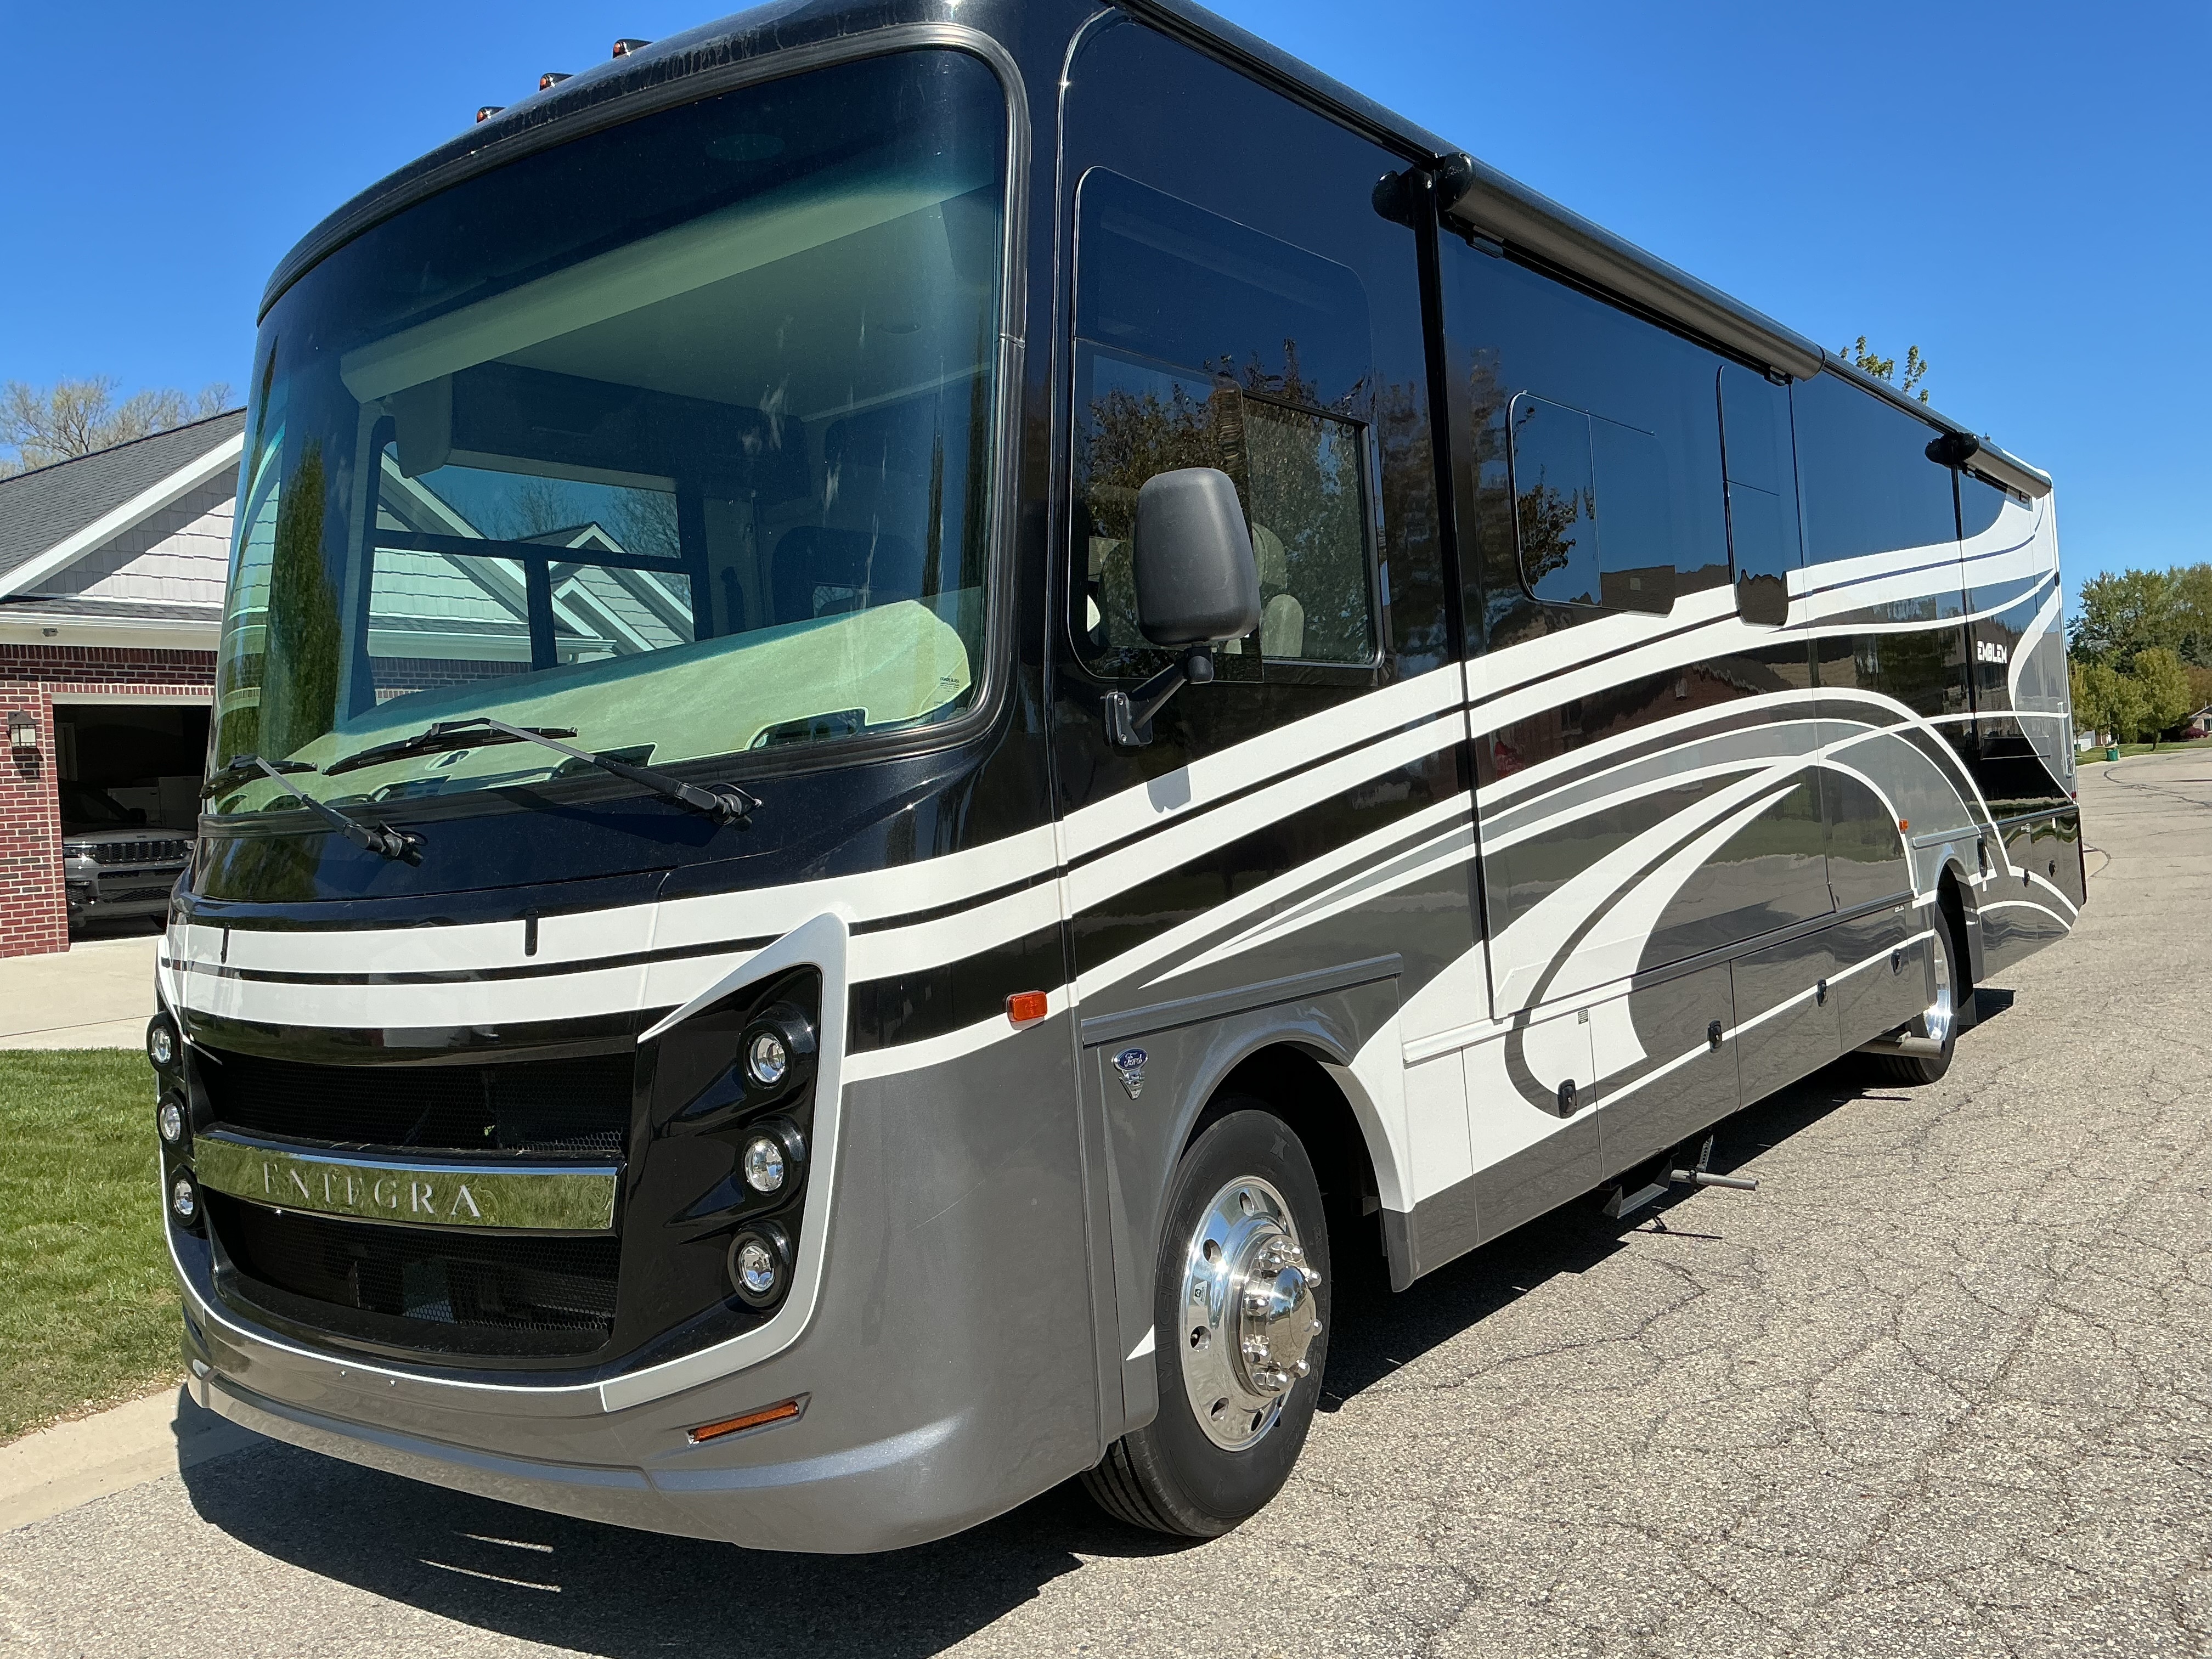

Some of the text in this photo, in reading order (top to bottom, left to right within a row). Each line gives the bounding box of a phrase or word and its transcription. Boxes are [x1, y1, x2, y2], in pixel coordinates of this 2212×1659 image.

[1977, 640, 2007, 664] EMBLEM
[1124, 1052, 1143, 1068] Ford
[264, 1161, 482, 1218] ENTEGRA
